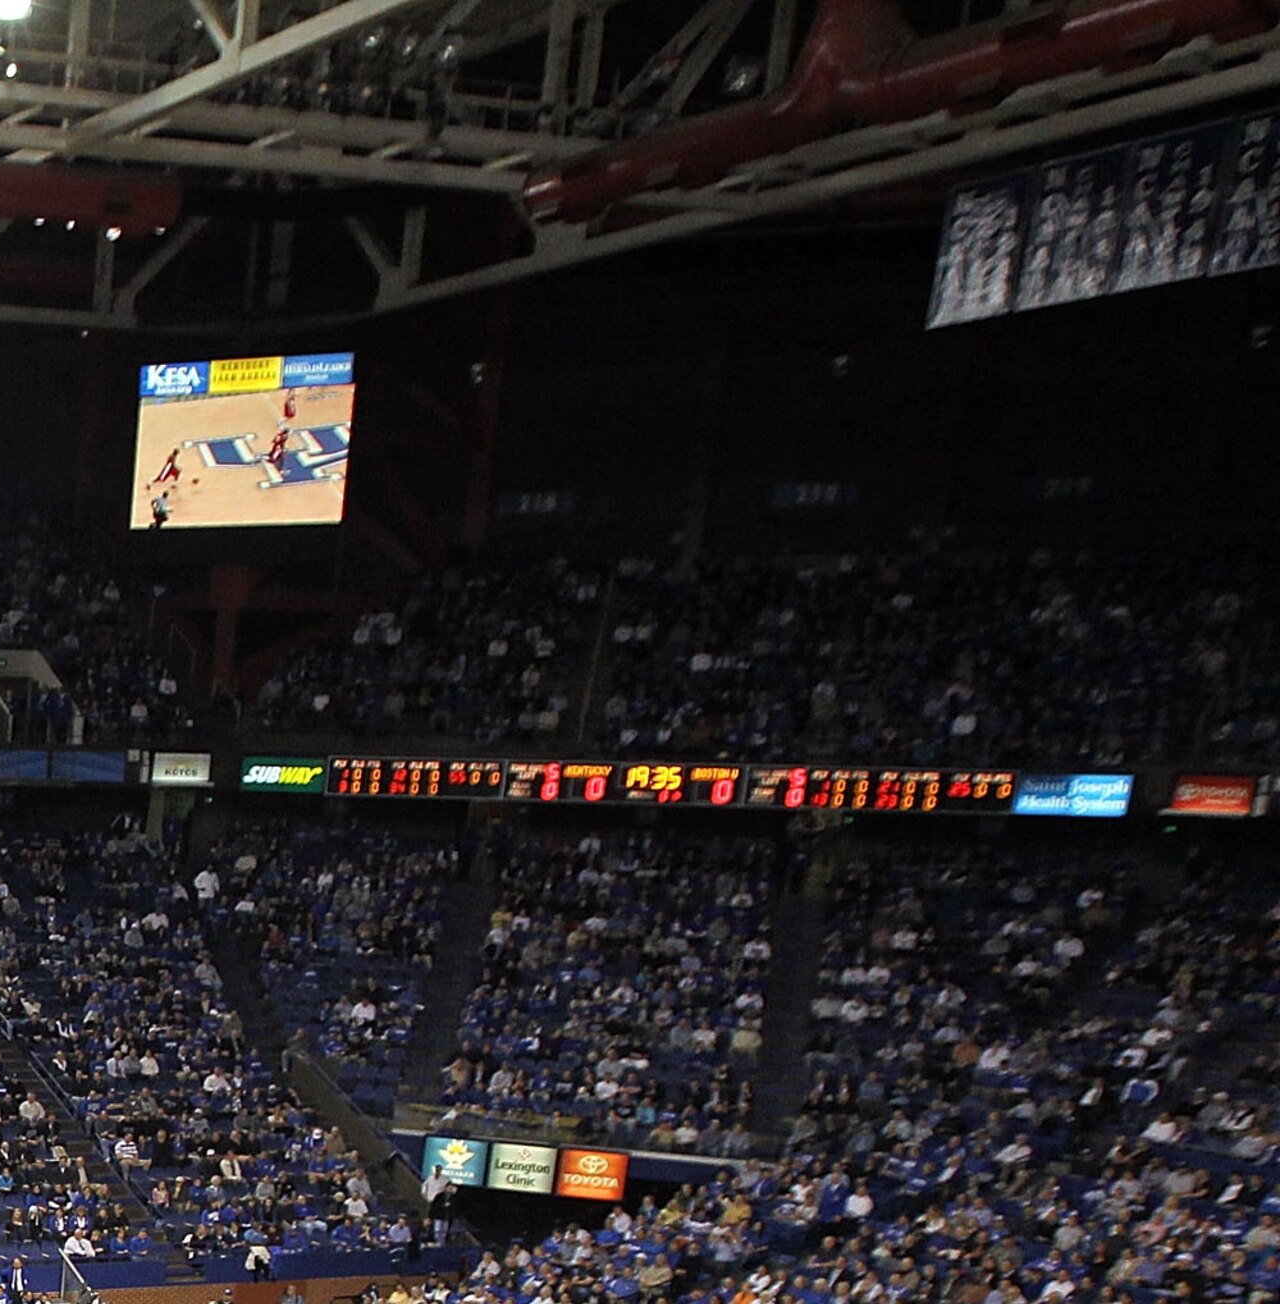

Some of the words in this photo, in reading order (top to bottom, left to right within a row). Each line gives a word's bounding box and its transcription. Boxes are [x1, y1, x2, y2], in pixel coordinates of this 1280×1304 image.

[243, 765, 323, 784] SUBWAY
[564, 765, 612, 777] KENTUCKY
[626, 766, 681, 790] 19:35
[691, 768, 726, 780] BOSTON
[585, 777, 606, 801] 0
[711, 780, 734, 805] 0
[1071, 780, 1130, 800] Joseph
[1022, 795, 1070, 809] Health
[1071, 797, 1126, 815] System
[496, 1158, 550, 1175] Lexington
[506, 1174, 536, 1187] Clinic
[563, 1174, 619, 1188] TOYOTA
